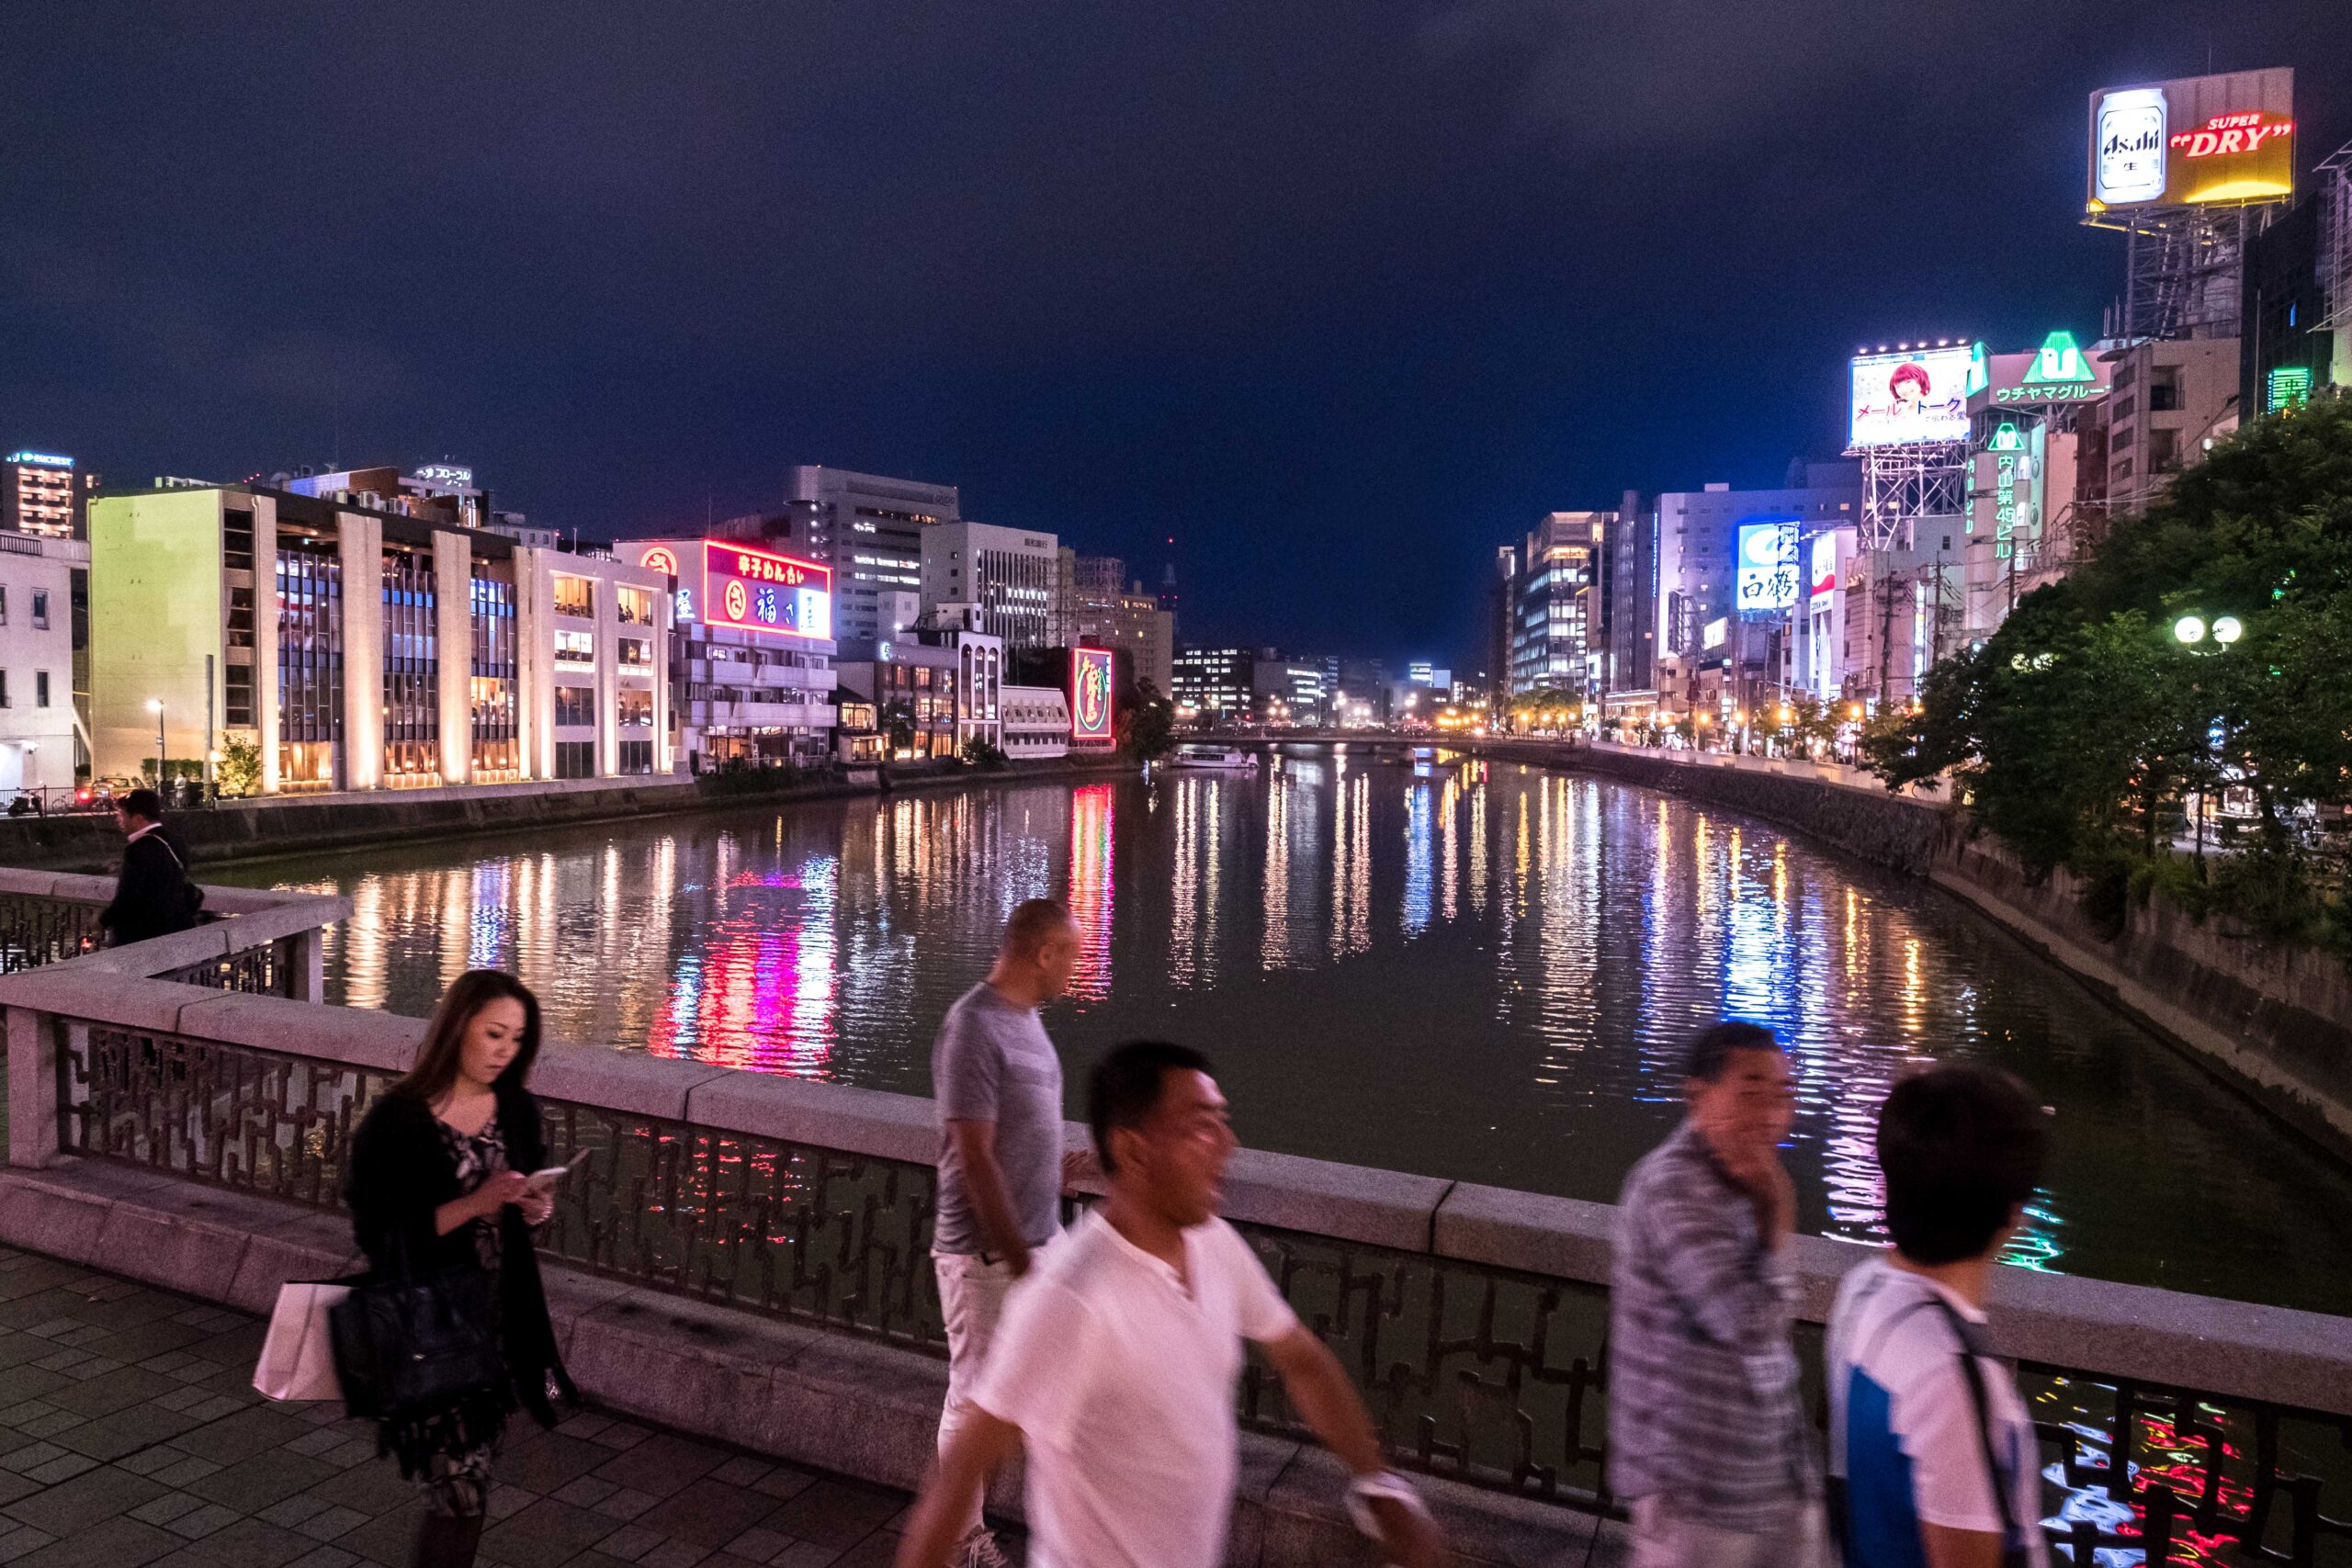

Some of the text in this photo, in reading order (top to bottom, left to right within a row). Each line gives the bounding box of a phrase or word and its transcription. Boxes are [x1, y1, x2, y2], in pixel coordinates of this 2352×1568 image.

[2208, 114, 2261, 130] SUPER
[2103, 129, 2159, 156] Asahi
[1996, 384, 2111, 402] ウチヤマグルー
[1856, 397, 1961, 421] メール トーク
[1995, 455, 2015, 559] 内山第45ビル
[738, 555, 804, 585] 辛子めんたい
